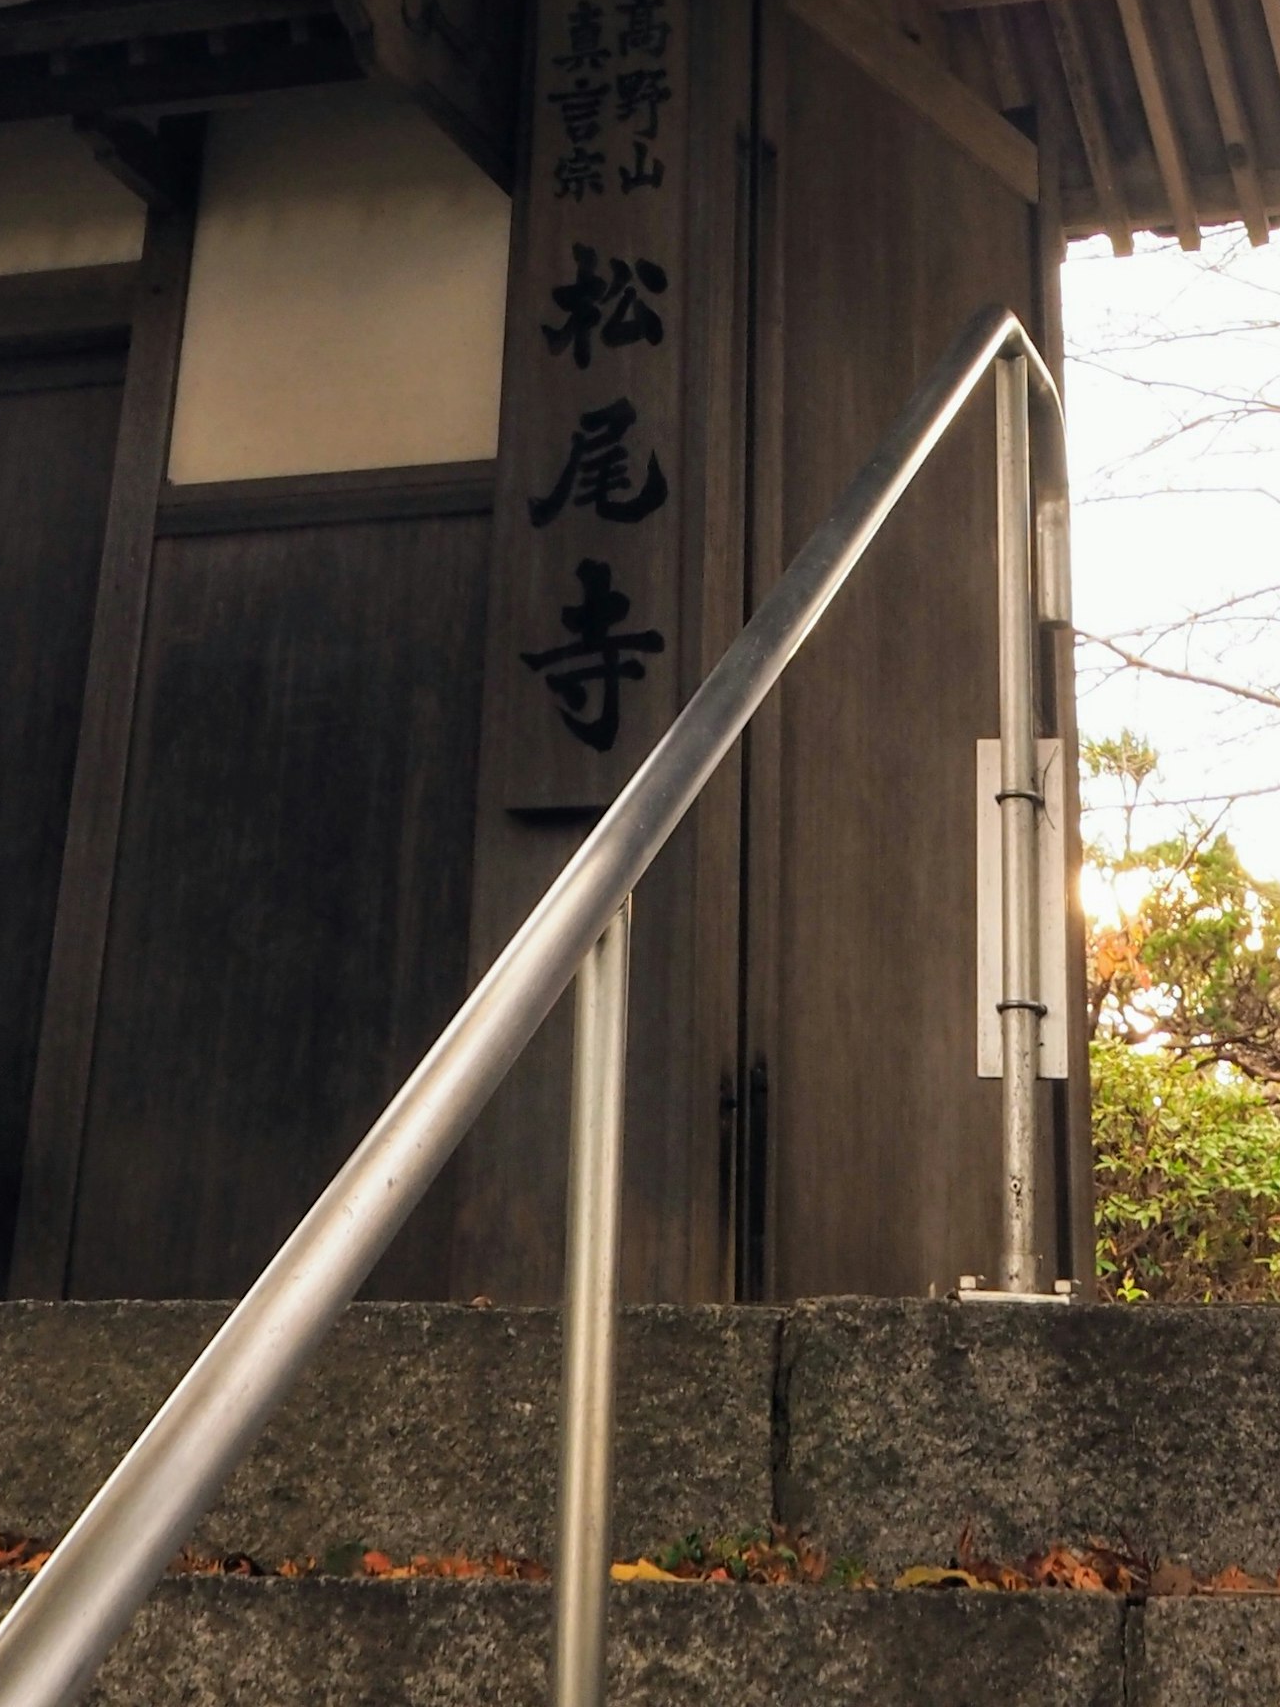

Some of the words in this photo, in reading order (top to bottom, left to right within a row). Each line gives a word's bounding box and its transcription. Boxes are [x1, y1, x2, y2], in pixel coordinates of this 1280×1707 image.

[548, 0, 611, 202] 真言宗
[520, 241, 668, 752] 松尾寺
